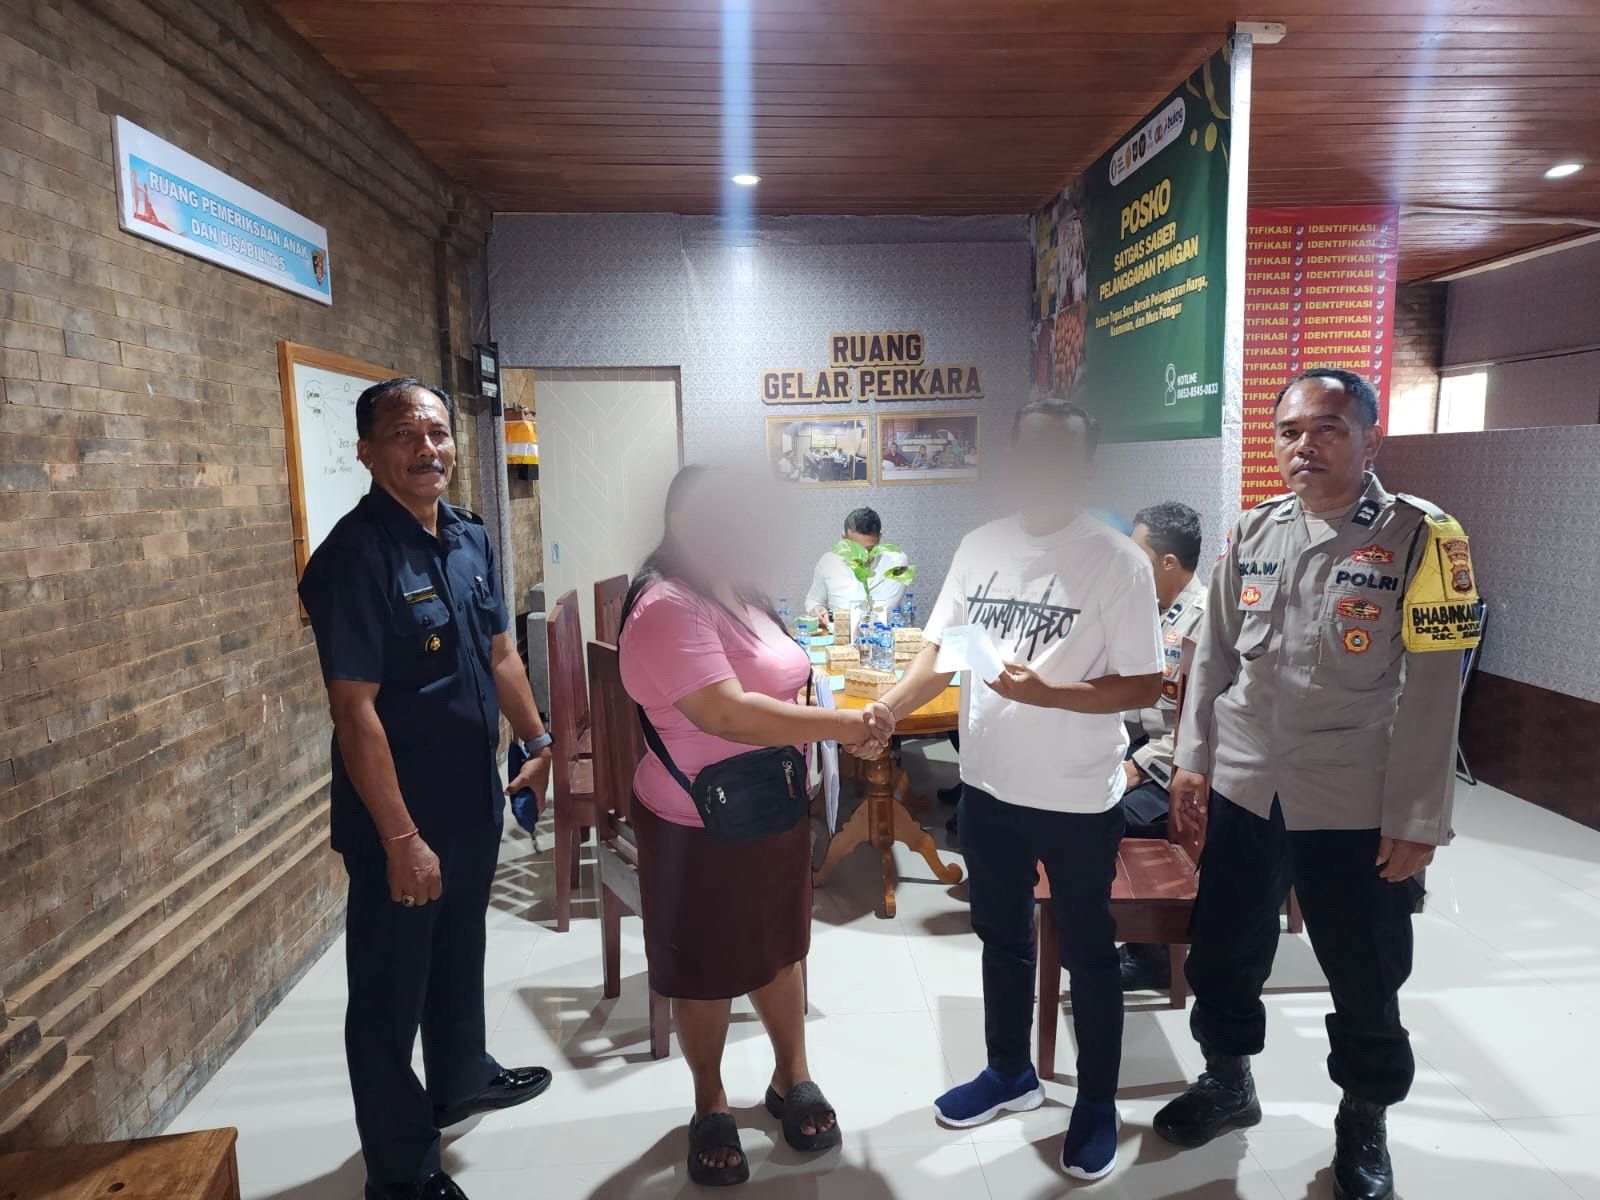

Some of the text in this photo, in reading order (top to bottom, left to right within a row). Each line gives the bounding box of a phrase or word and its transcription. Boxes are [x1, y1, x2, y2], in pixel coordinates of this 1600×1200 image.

[149, 170, 309, 258] RUANG PEMERIKSAAN ANAK
[1120, 178, 1171, 240] POSKO
[1248, 224, 1376, 234] TIFIKASI IDENTIFIKASI
[191, 219, 286, 271] DAN DISABILITAS
[1114, 221, 1176, 272] SATGAS SABER
[1248, 240, 1376, 250] TIFIKASI IDENTIFIKASI
[1248, 254, 1374, 265] TIFIKASI IDENTIFIKASI
[1100, 235, 1199, 301] PELANGGARAN PANGAN
[1247, 270, 1374, 280] TIFIKASI IDENTIFIKASI
[1246, 285, 1373, 296] TIFIKASI IDENTIFIKASI
[1246, 300, 1372, 310] TIFIKASI IDENTIFIKASI
[1246, 315, 1371, 326] TIFIKASI IDENTIFIKASI
[1245, 330, 1371, 341] TIFIKASI IDENTIFIKASI
[833, 334, 922, 363] RUANG
[1244, 345, 1370, 356] TIFIKASI IDENTIFIKASI
[1244, 360, 1370, 370] TIFIKASI IDENTIFIKASI
[764, 366, 981, 399] GELAR PERKARA
[1244, 378, 1286, 386] TIFIKASI
[1244, 392, 1277, 400] TIFIKA
[1242, 422, 1274, 430] TIFIKA
[1242, 480, 1282, 488] TIFIKASI
[1239, 560, 1278, 576] KA.W
[1335, 570, 1399, 591] POLRI
[1415, 623, 1480, 634] DESA BATU
